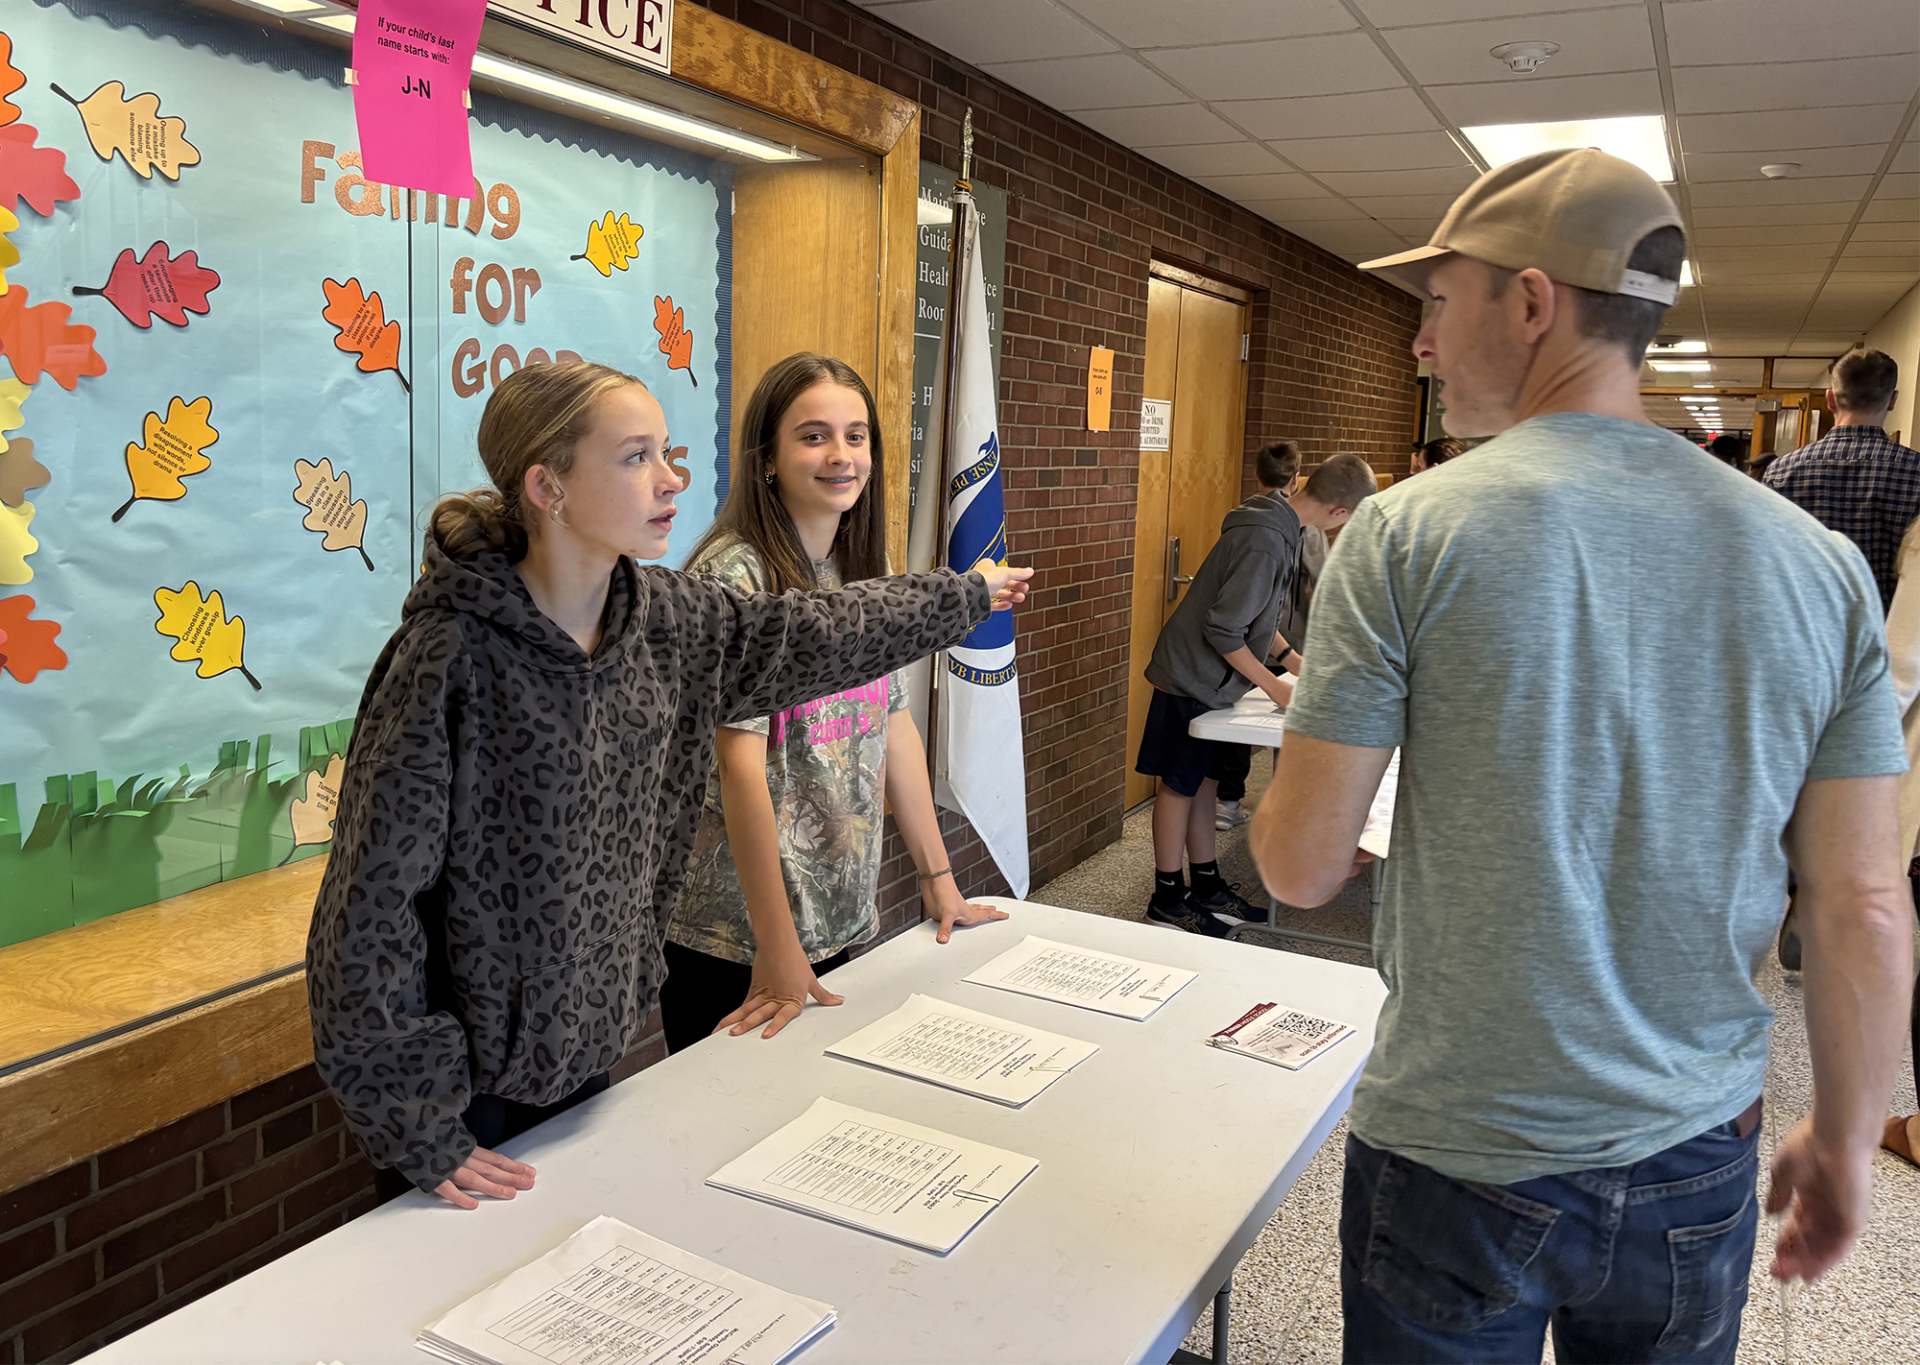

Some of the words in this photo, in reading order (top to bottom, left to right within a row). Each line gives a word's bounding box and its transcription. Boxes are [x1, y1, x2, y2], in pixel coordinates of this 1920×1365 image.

[378, 16, 384, 28] If
[386, 20, 406, 34] your
[408, 28, 436, 44] child's
[438, 36, 455, 50] last
[537, 0, 662, 54] ICE
[378, 37, 402, 50] name
[404, 44, 428, 58] starts
[431, 52, 450, 65] with:
[402, 75, 430, 100] J-N
[160, 149, 166, 158] up
[922, 187, 949, 209] Main
[141, 274, 151, 293] mess
[149, 294, 156, 304] up
[147, 270, 156, 286] after
[154, 287, 163, 302] they
[154, 269, 171, 303] teammate
[159, 259, 179, 303] Encouraging
[344, 315, 361, 338] Listening
[356, 325, 370, 346] opinion
[368, 312, 376, 326] even
[370, 326, 383, 349] disagree
[1145, 405, 1156, 415] NO
[153, 433, 192, 459] disagreement
[159, 427, 188, 448] Resolving
[147, 448, 157, 456] not
[157, 454, 179, 469] silence
[153, 442, 165, 452] with
[166, 450, 186, 465] words,
[153, 460, 172, 474] drama
[306, 476, 327, 505] Speaking
[315, 498, 322, 507] up
[320, 490, 326, 499] in
[322, 493, 333, 510] class
[322, 489, 344, 523] discussion
[328, 503, 344, 527] instead
[343, 495, 348, 504] of
[336, 505, 352, 528] staying
[343, 512, 356, 530] silent
[182, 606, 204, 641] Choosing
[190, 612, 210, 645] kindness
[196, 637, 206, 653] over
[204, 611, 219, 636] gossip
[971, 661, 1016, 685] LIBERTA
[810, 716, 853, 745] CLOUD
[858, 712, 869, 734] 9
[316, 792, 329, 803] work
[318, 782, 337, 798] Turning
